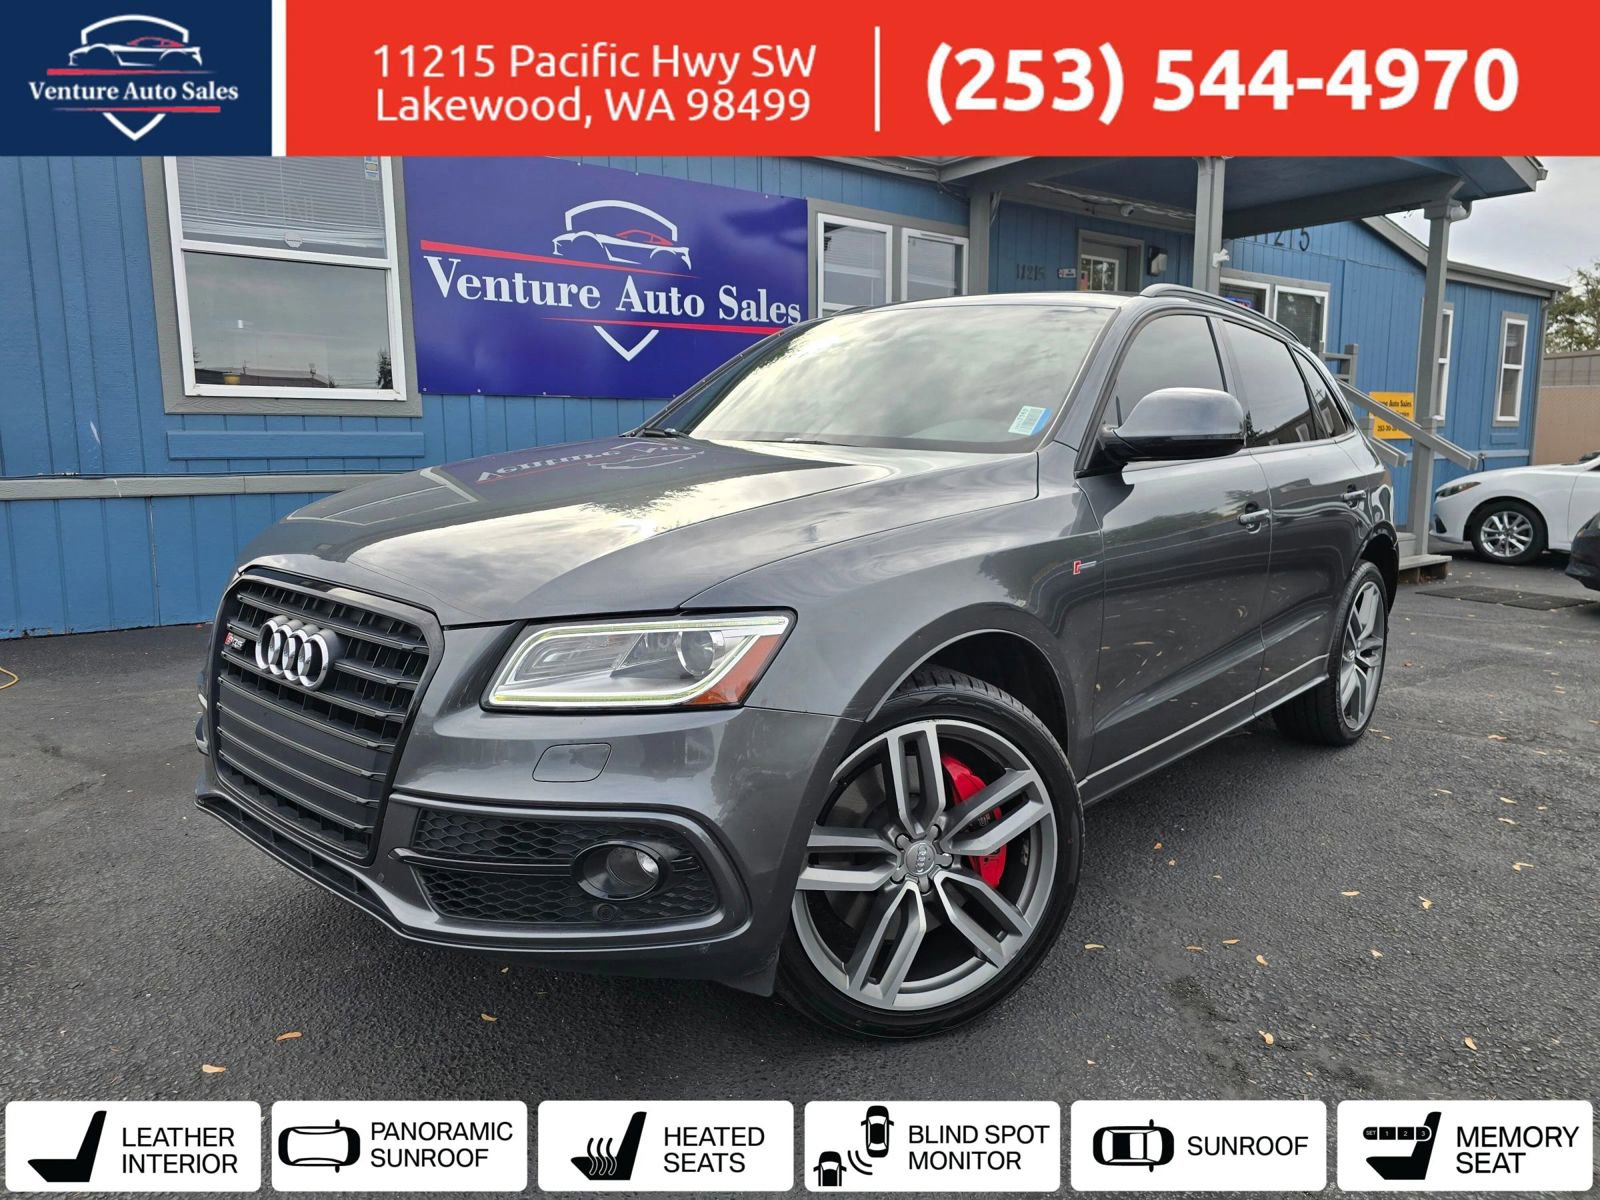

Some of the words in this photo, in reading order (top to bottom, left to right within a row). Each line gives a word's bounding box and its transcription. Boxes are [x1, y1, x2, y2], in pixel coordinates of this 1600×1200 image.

[423, 255, 601, 309] Venture
[615, 274, 705, 318] Auto
[718, 285, 801, 325] Sales
